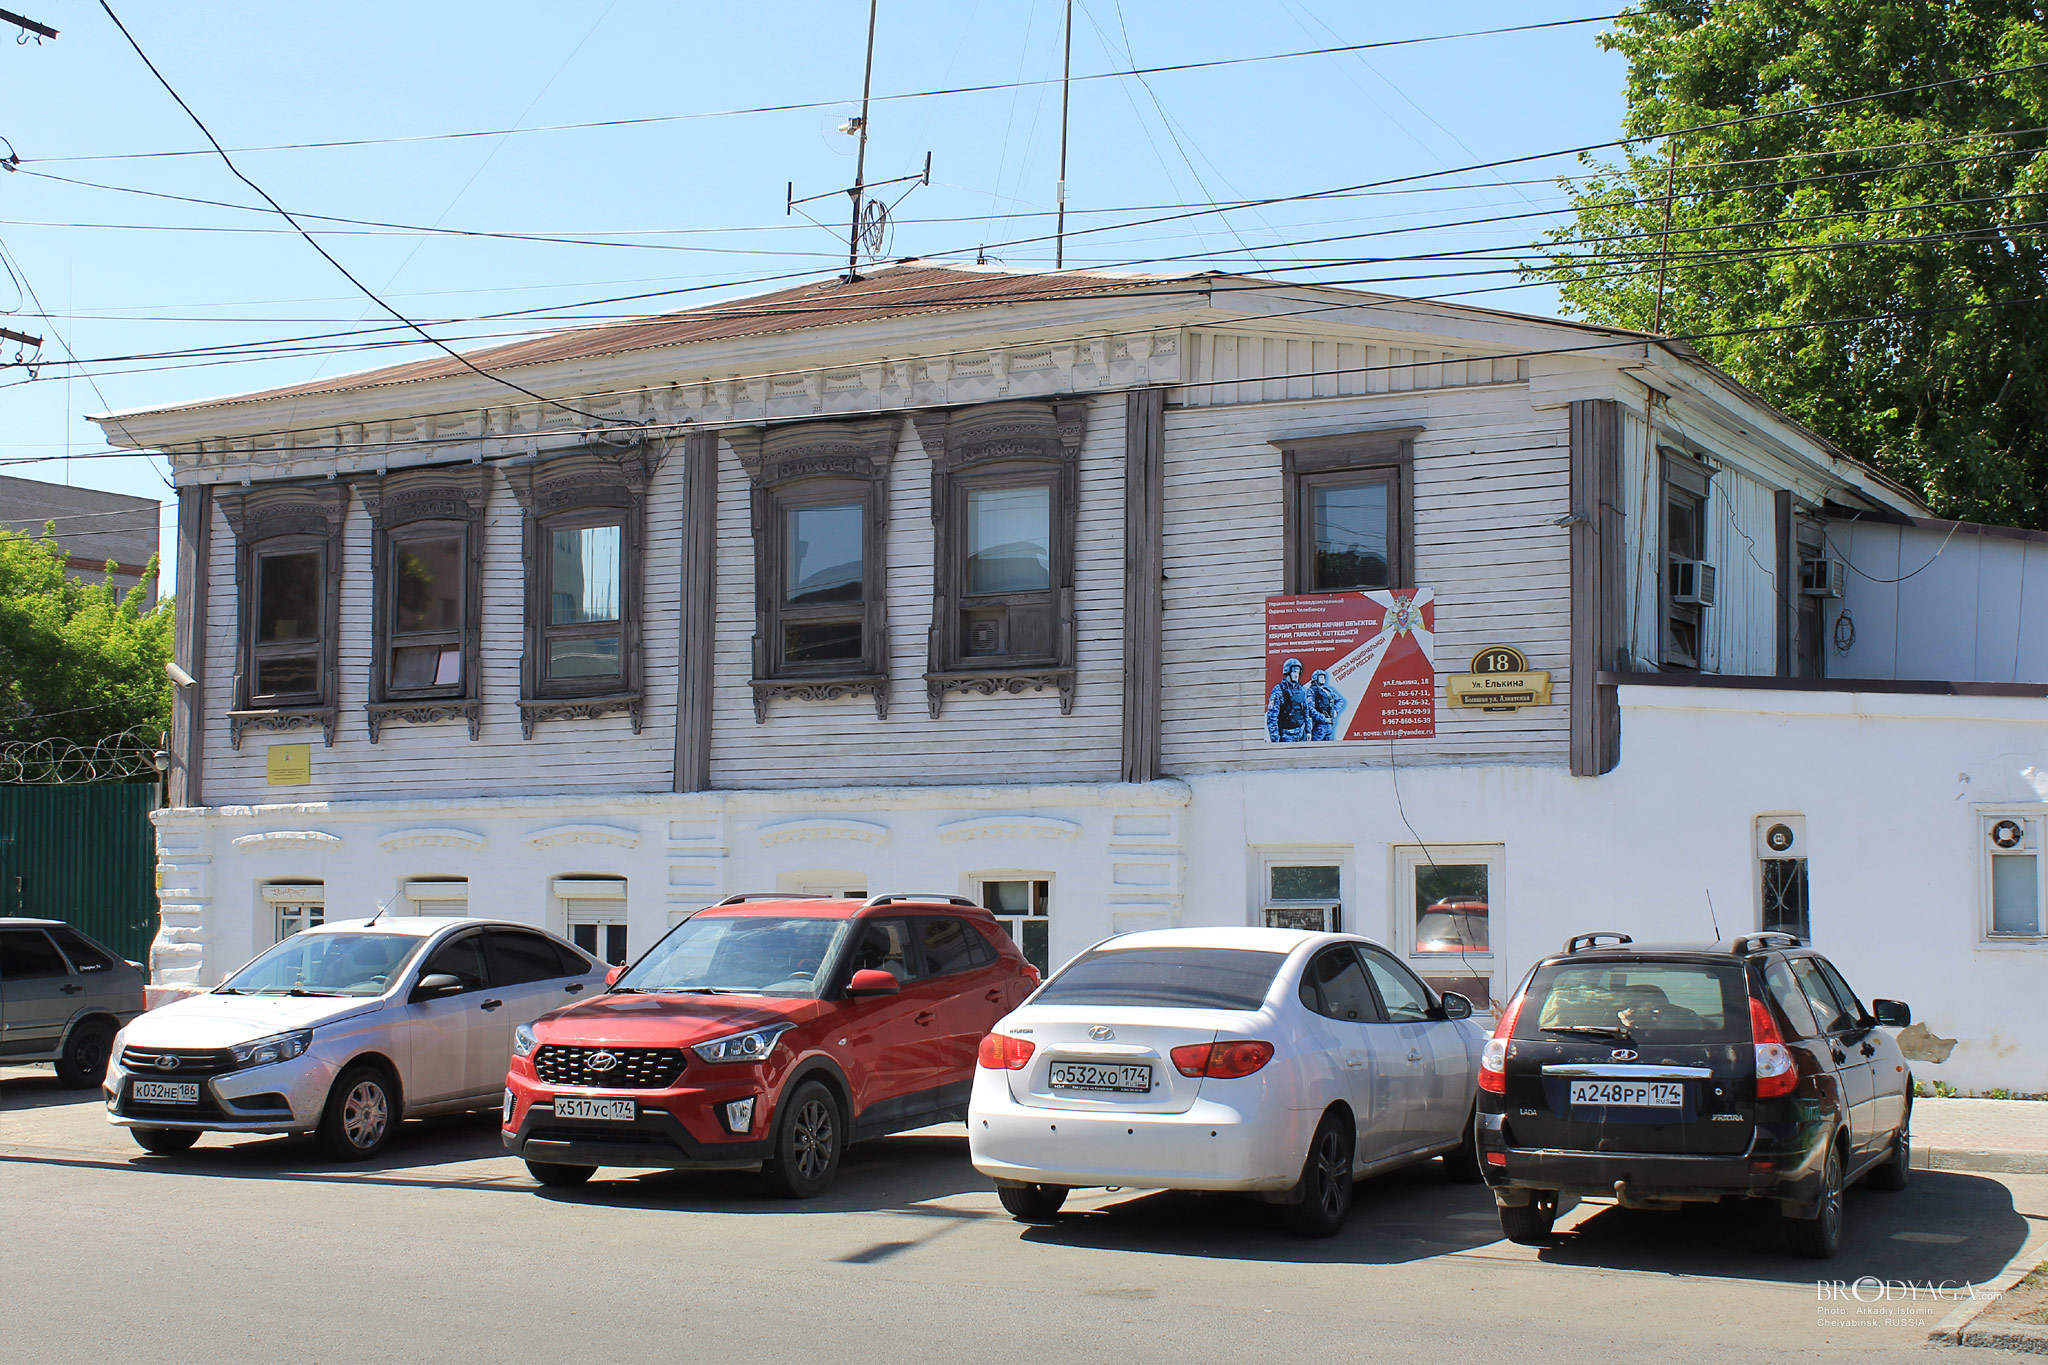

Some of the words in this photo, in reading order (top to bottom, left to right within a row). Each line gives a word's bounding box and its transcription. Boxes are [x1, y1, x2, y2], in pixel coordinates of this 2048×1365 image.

[1269, 622, 1321, 630] ГОСУДАРСТВЕННАЯ
[1322, 620, 1344, 628] ОХРАНА
[1293, 630, 1321, 638] ГАРАЖЕЙ,
[1323, 628, 1358, 636] КОТТЕДЖЕЙ
[1332, 662, 1350, 676] ВОЙСКА
[1350, 636, 1386, 664] НАЦИОНАЛЬНОЙ
[1487, 654, 1509, 671] 18
[1335, 666, 1356, 683] ГВАРДИИ
[1356, 653, 1375, 668] РОССИИ
[1485, 679, 1524, 688] Елькина
[1381, 708, 1431, 716] 8-951-474-09-93
[1056, 1066, 1118, 1085] О532ХО
[1122, 1068, 1145, 1082] 174
[136, 1083, 178, 1098] К032НЕ
[179, 1084, 196, 1096] 186
[1576, 1084, 1647, 1103] А248РР
[1651, 1085, 1678, 1099] 174
[559, 1100, 609, 1117] Х517УС
[612, 1102, 631, 1114] 174
